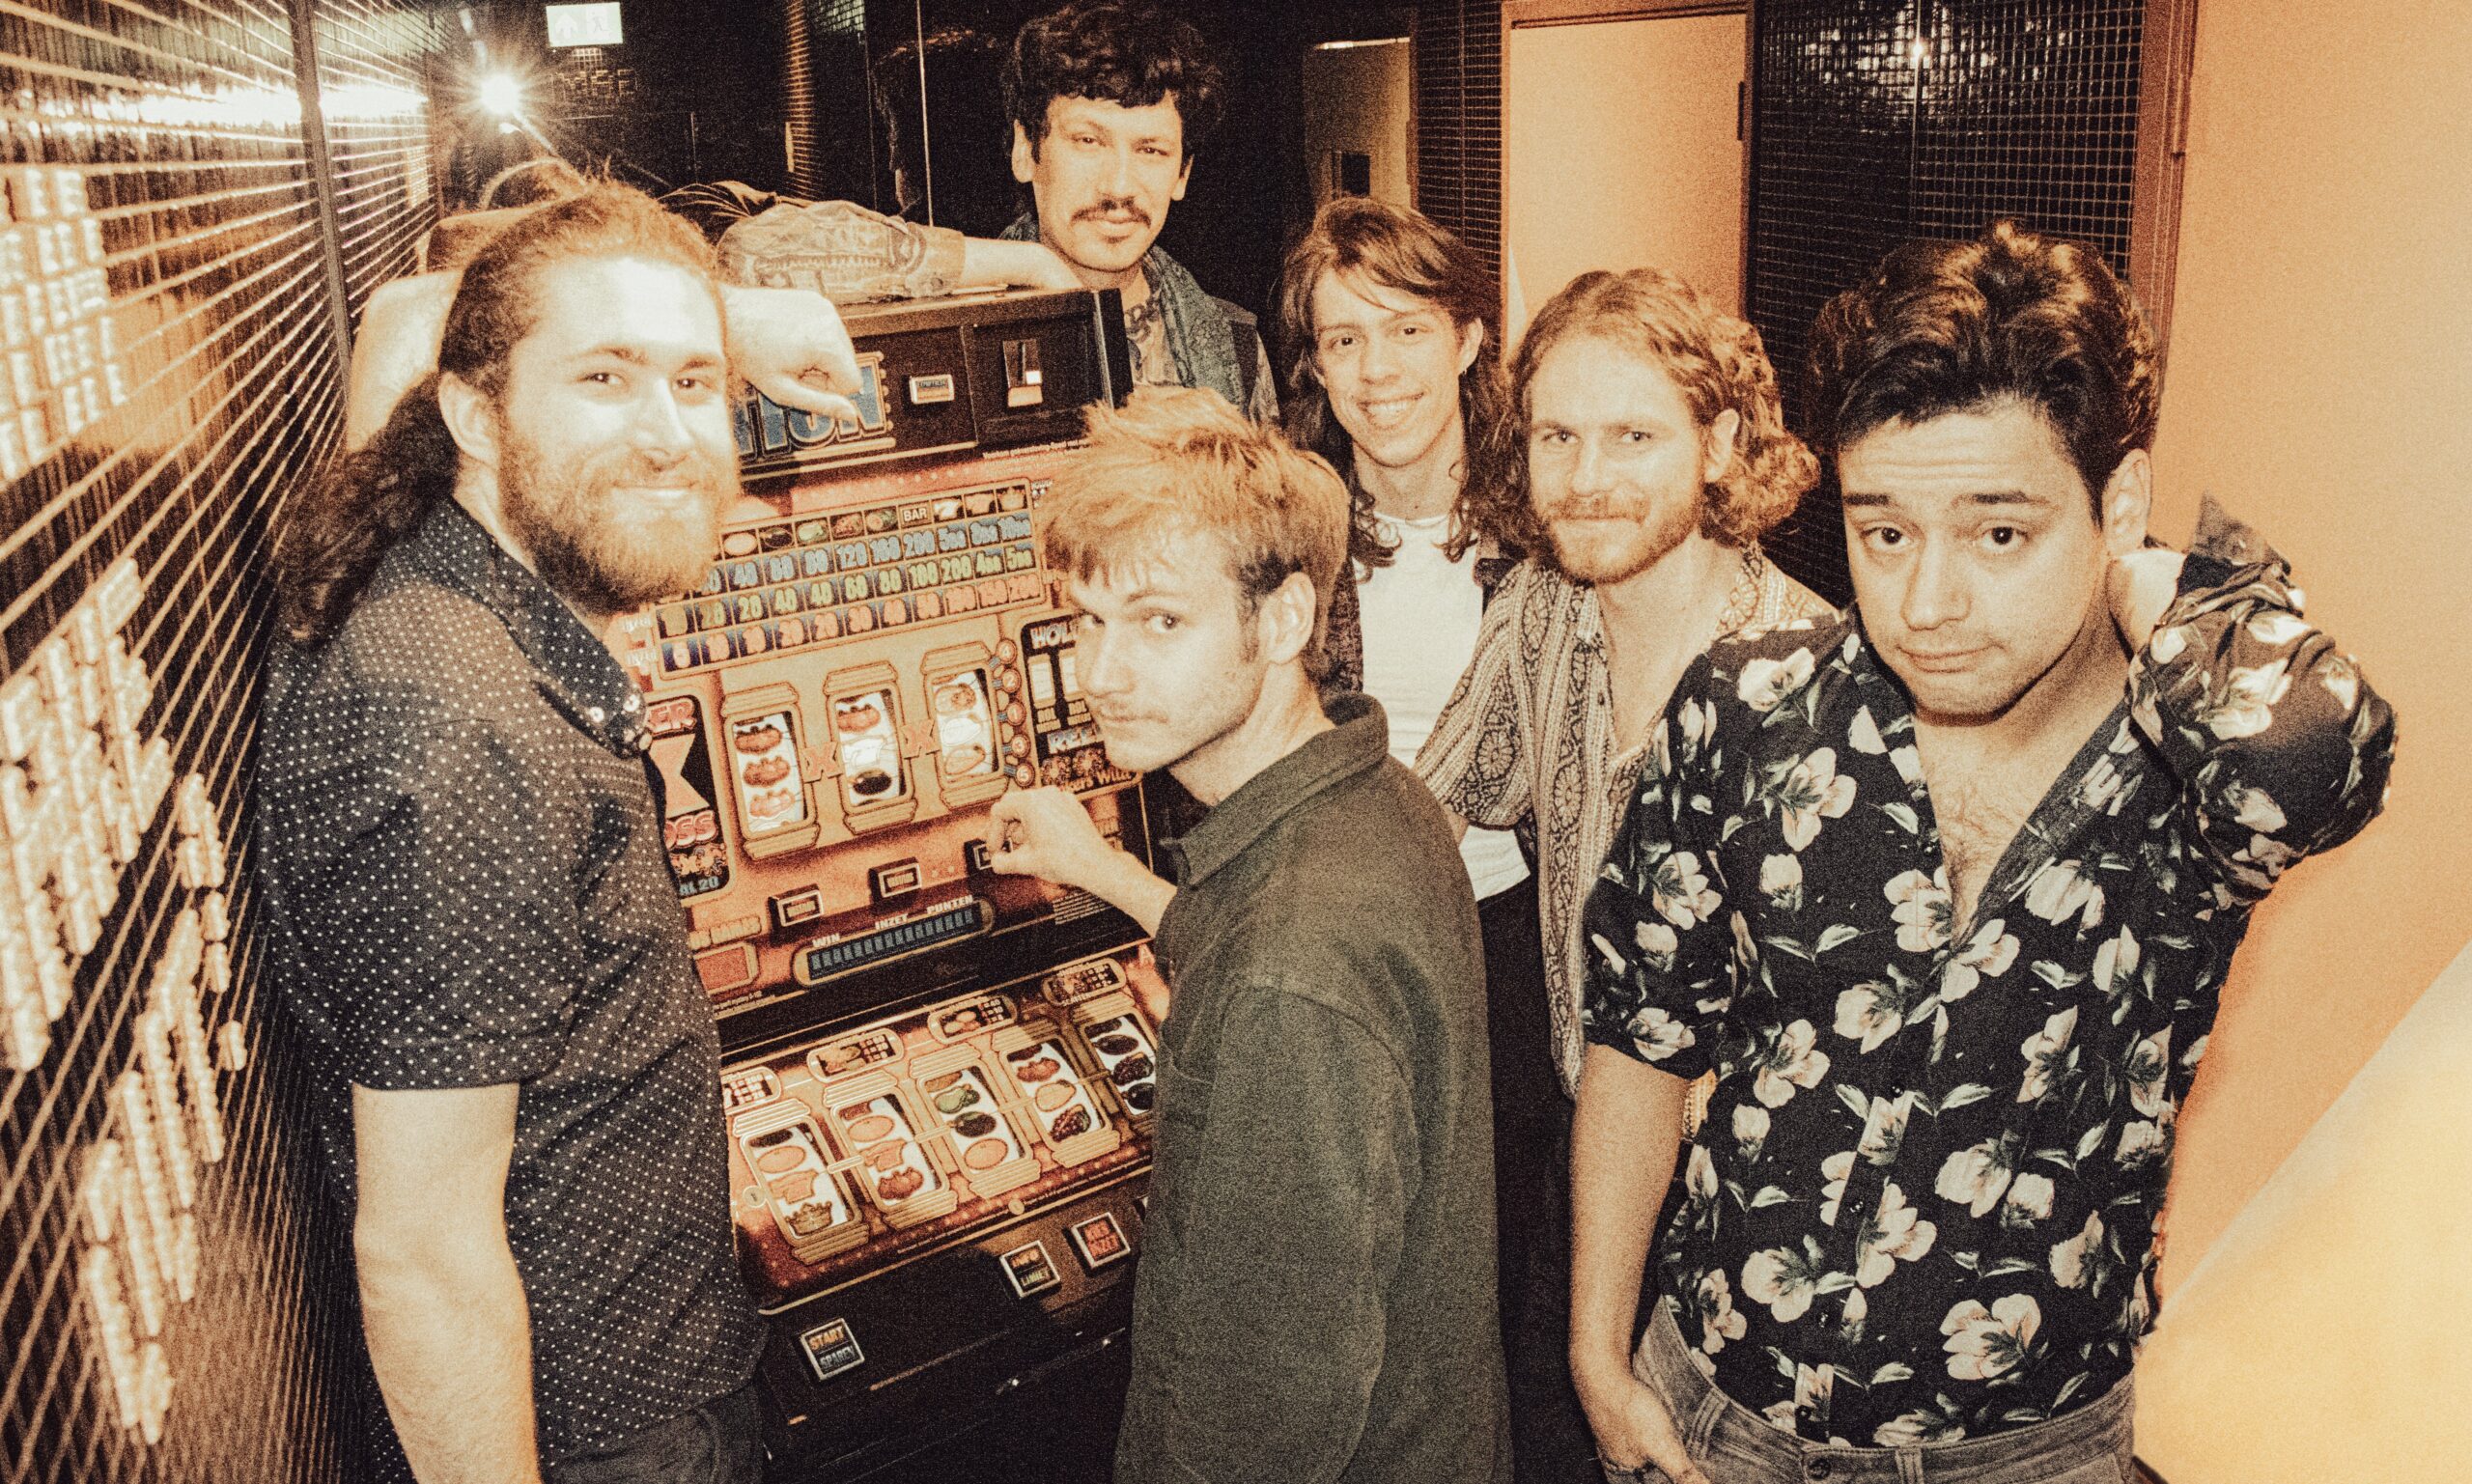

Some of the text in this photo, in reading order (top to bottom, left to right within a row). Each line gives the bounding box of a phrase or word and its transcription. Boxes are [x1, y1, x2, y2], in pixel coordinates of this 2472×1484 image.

[734, 359, 886, 454] ION
[903, 508, 927, 522] BAR
[734, 561, 759, 587] 40
[835, 543, 867, 570] 120
[904, 530, 935, 557] 200
[738, 595, 763, 622] 20
[774, 588, 798, 612] 40
[810, 582, 833, 605] 40
[844, 574, 868, 600] 60
[879, 569, 902, 594] 80
[910, 561, 939, 589] 100
[941, 555, 972, 581] 200
[1047, 724, 1101, 754] REE
[699, 876, 719, 890] 20
[812, 894, 974, 947] WIN INZET PUNTEN
[1010, 1248, 1040, 1268] INFO
[809, 1326, 845, 1350] START
